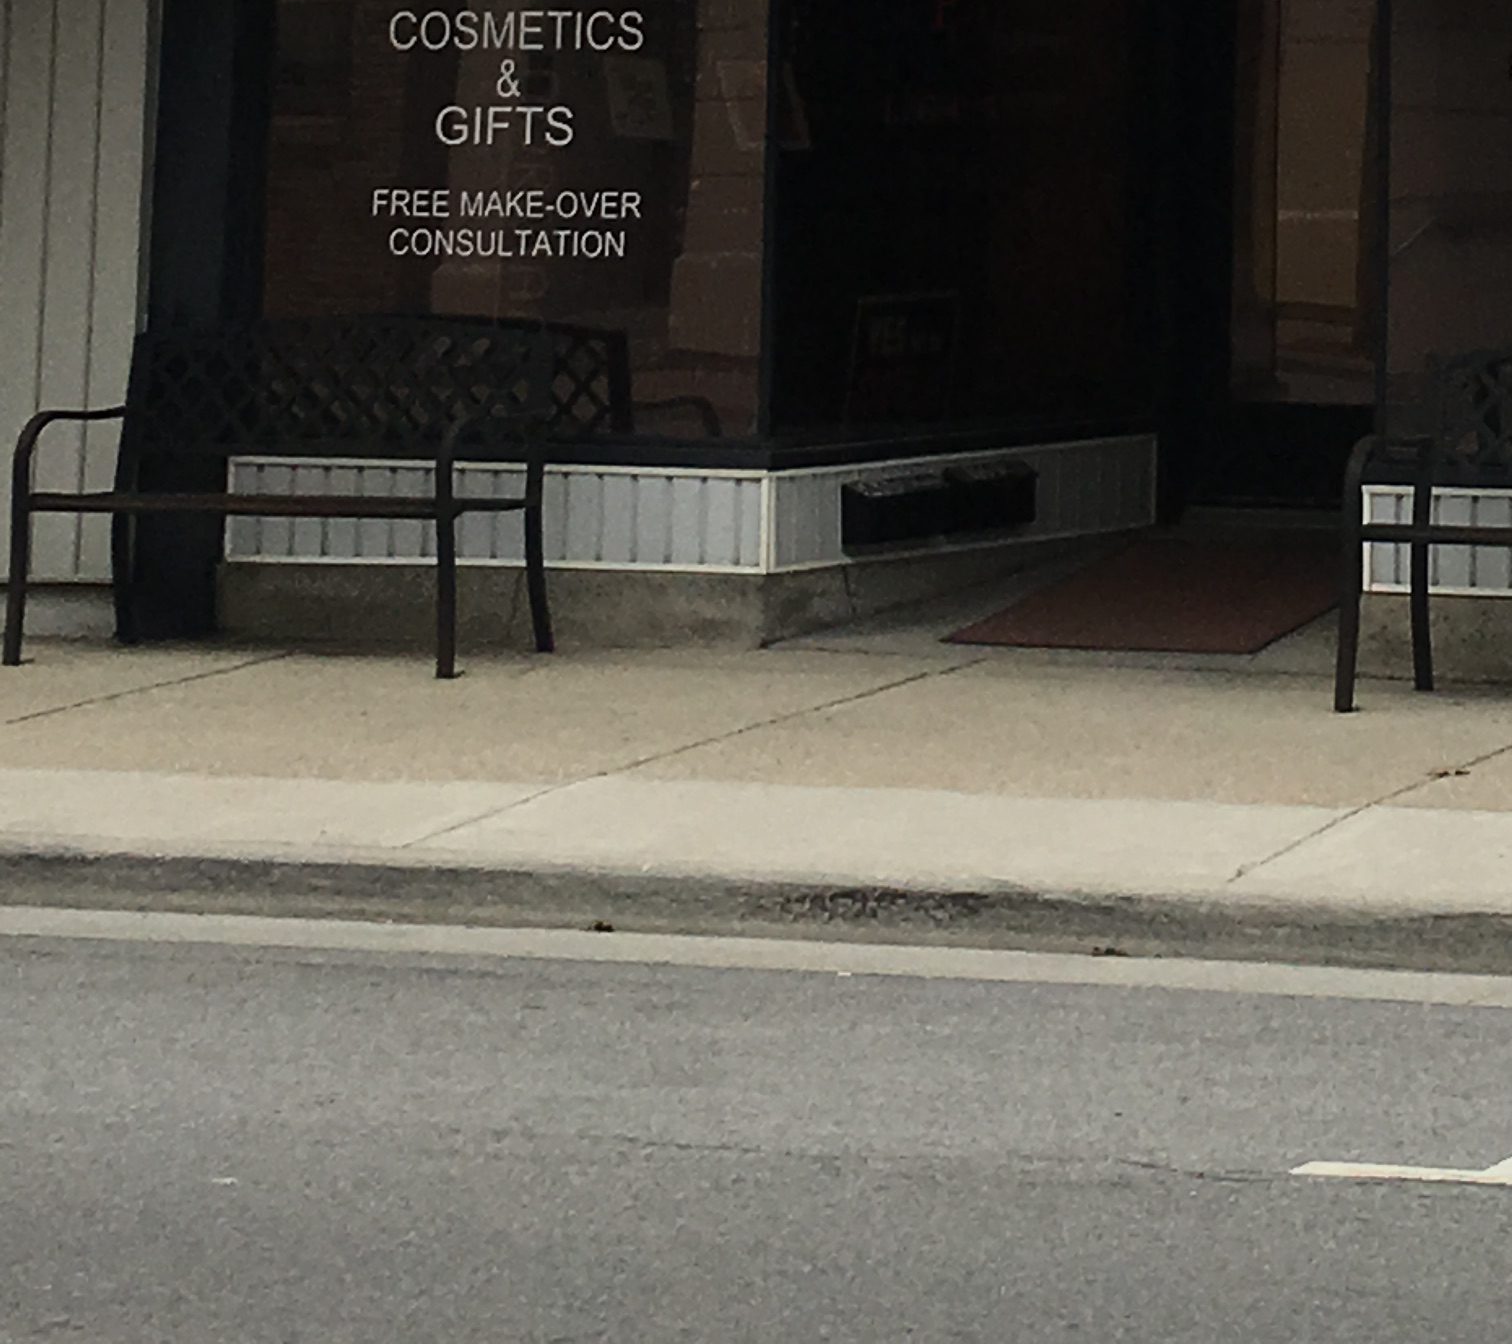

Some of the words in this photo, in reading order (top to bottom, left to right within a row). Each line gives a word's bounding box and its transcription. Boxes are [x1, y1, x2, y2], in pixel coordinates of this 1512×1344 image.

[388, 10, 644, 51] COSMETICS
[496, 58, 522, 98] &
[435, 106, 574, 145] GIFTS
[371, 188, 450, 217] FREE
[460, 190, 642, 219] MAKE-OVER
[388, 228, 625, 257] CONSULTATION
